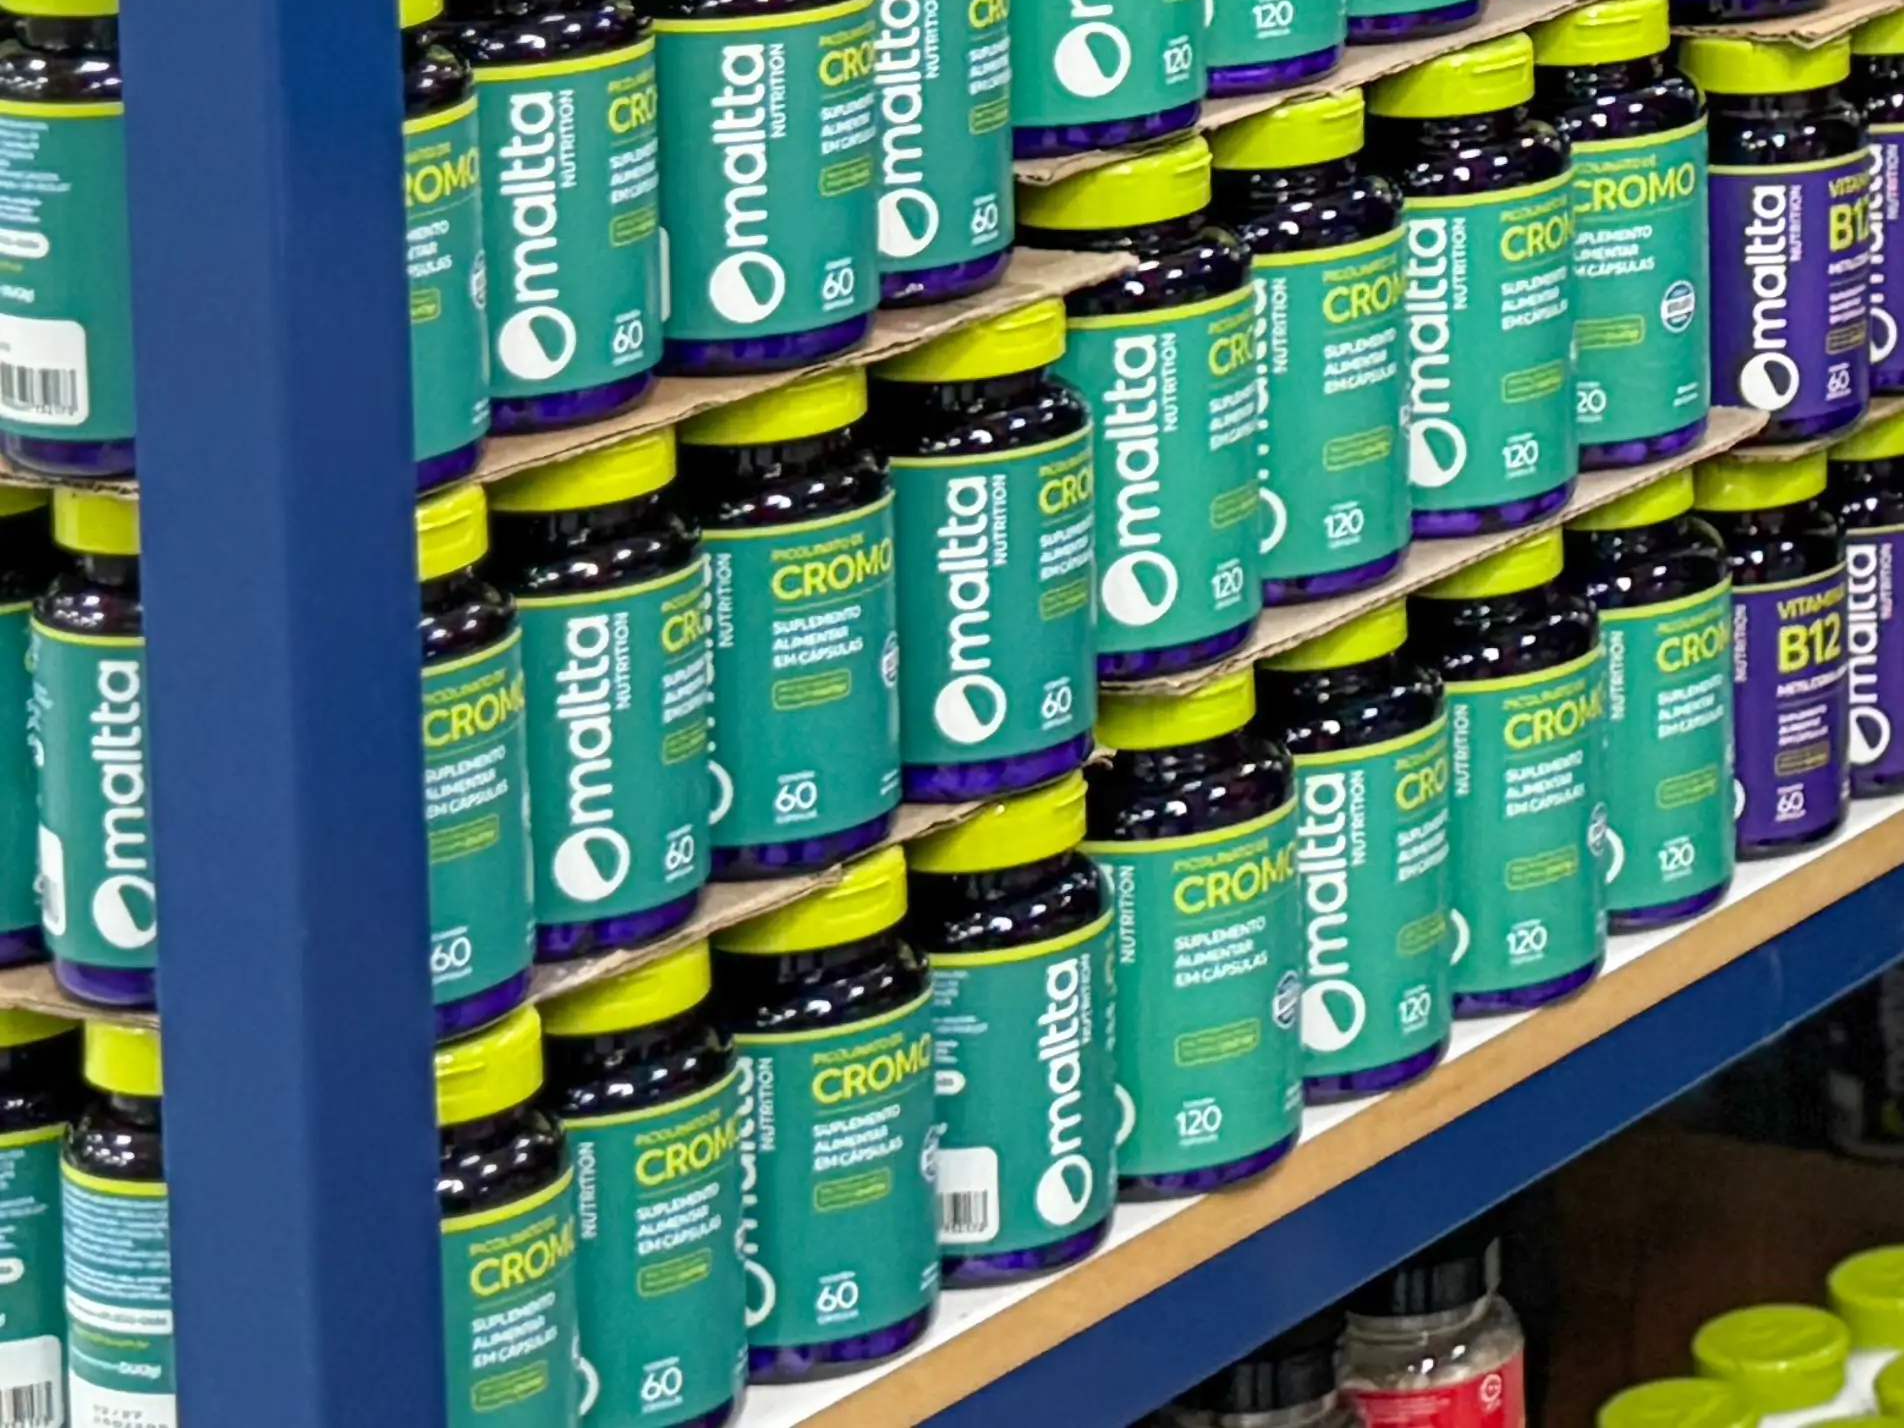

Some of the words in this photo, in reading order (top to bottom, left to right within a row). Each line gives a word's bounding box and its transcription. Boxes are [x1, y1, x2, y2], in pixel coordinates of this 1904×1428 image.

[1251, 0, 1294, 30] 120
[1162, 45, 1193, 75] 120
[769, 42, 787, 139] NUTRITION
[557, 89, 577, 188] NUTRITION
[710, 43, 769, 248] maltta
[498, 90, 560, 304] maltta
[971, 201, 999, 235] 60
[1451, 217, 1468, 311] NUTRITION
[1744, 184, 1788, 350] maltta
[822, 265, 855, 301] 60
[612, 319, 644, 354] 60
[1272, 276, 1289, 375] NUTRITION
[1160, 332, 1178, 433] NUTRITION
[1576, 387, 1607, 415] 20
[1103, 333, 1162, 549] maltta
[1502, 438, 1539, 470] 120
[991, 473, 1009, 566] NUTRITION
[1323, 508, 1365, 540] 120
[936, 475, 991, 673] maltta
[1211, 566, 1244, 600] 120
[715, 553, 734, 647] NUTRITION
[772, 604, 862, 637] SUPLEMENTO
[772, 626, 849, 652] ALIMENTAR
[1777, 611, 1841, 674] B12
[613, 612, 631, 710] NUTRITION
[773, 649, 796, 670] EM
[1609, 630, 1625, 721] NUTRITION
[1040, 684, 1073, 720] 60
[556, 615, 614, 826] maltta
[90, 660, 148, 870] maltta
[1453, 702, 1470, 798] NUTRITION
[774, 781, 818, 814] 60
[1777, 790, 1805, 815] 60
[1350, 769, 1367, 866] NUTRITION
[665, 835, 695, 872] 60
[1658, 841, 1695, 872] 120
[1119, 864, 1136, 964] NUTRITION
[1174, 915, 1267, 950] SUPLEMENTO
[1506, 924, 1547, 956] 120
[429, 936, 472, 971] 60
[1174, 939, 1254, 969] ALIMENTAR
[1175, 971, 1200, 988] EM
[1398, 990, 1432, 1026] 120
[757, 1056, 776, 1152] NUTRITION
[813, 1103, 901, 1138] SUPLEMENTO
[1175, 1103, 1223, 1136] 120
[813, 1124, 890, 1154] ALIMENTAR
[814, 1154, 840, 1172] EM
[578, 1141, 598, 1240] NUTRITION
[815, 1280, 859, 1313] 60
[641, 1366, 683, 1402] 60
